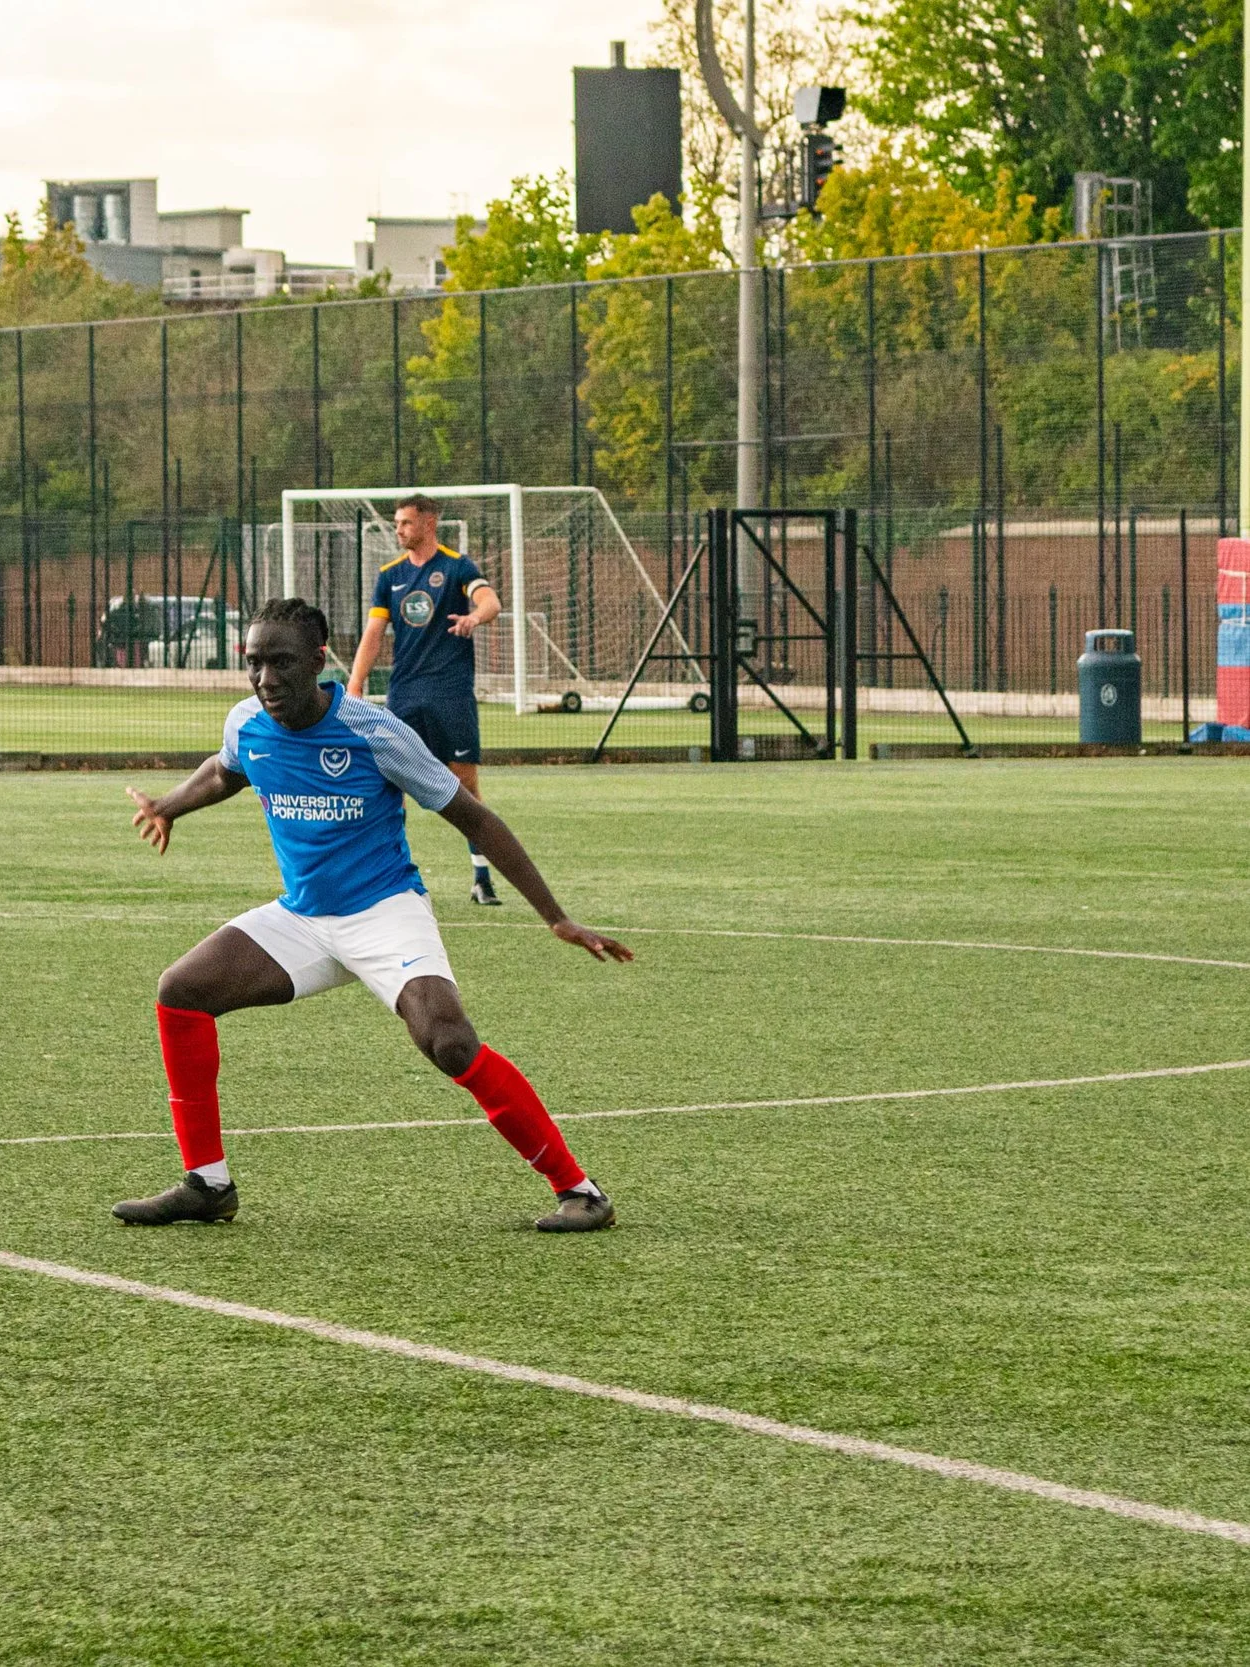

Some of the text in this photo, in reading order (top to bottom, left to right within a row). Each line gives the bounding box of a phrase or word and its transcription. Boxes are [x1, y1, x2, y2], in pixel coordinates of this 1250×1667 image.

[405, 600, 430, 614] ESS
[270, 793, 364, 808] UNIVERSITY OF
[272, 806, 364, 821] PORTSMOUTH
